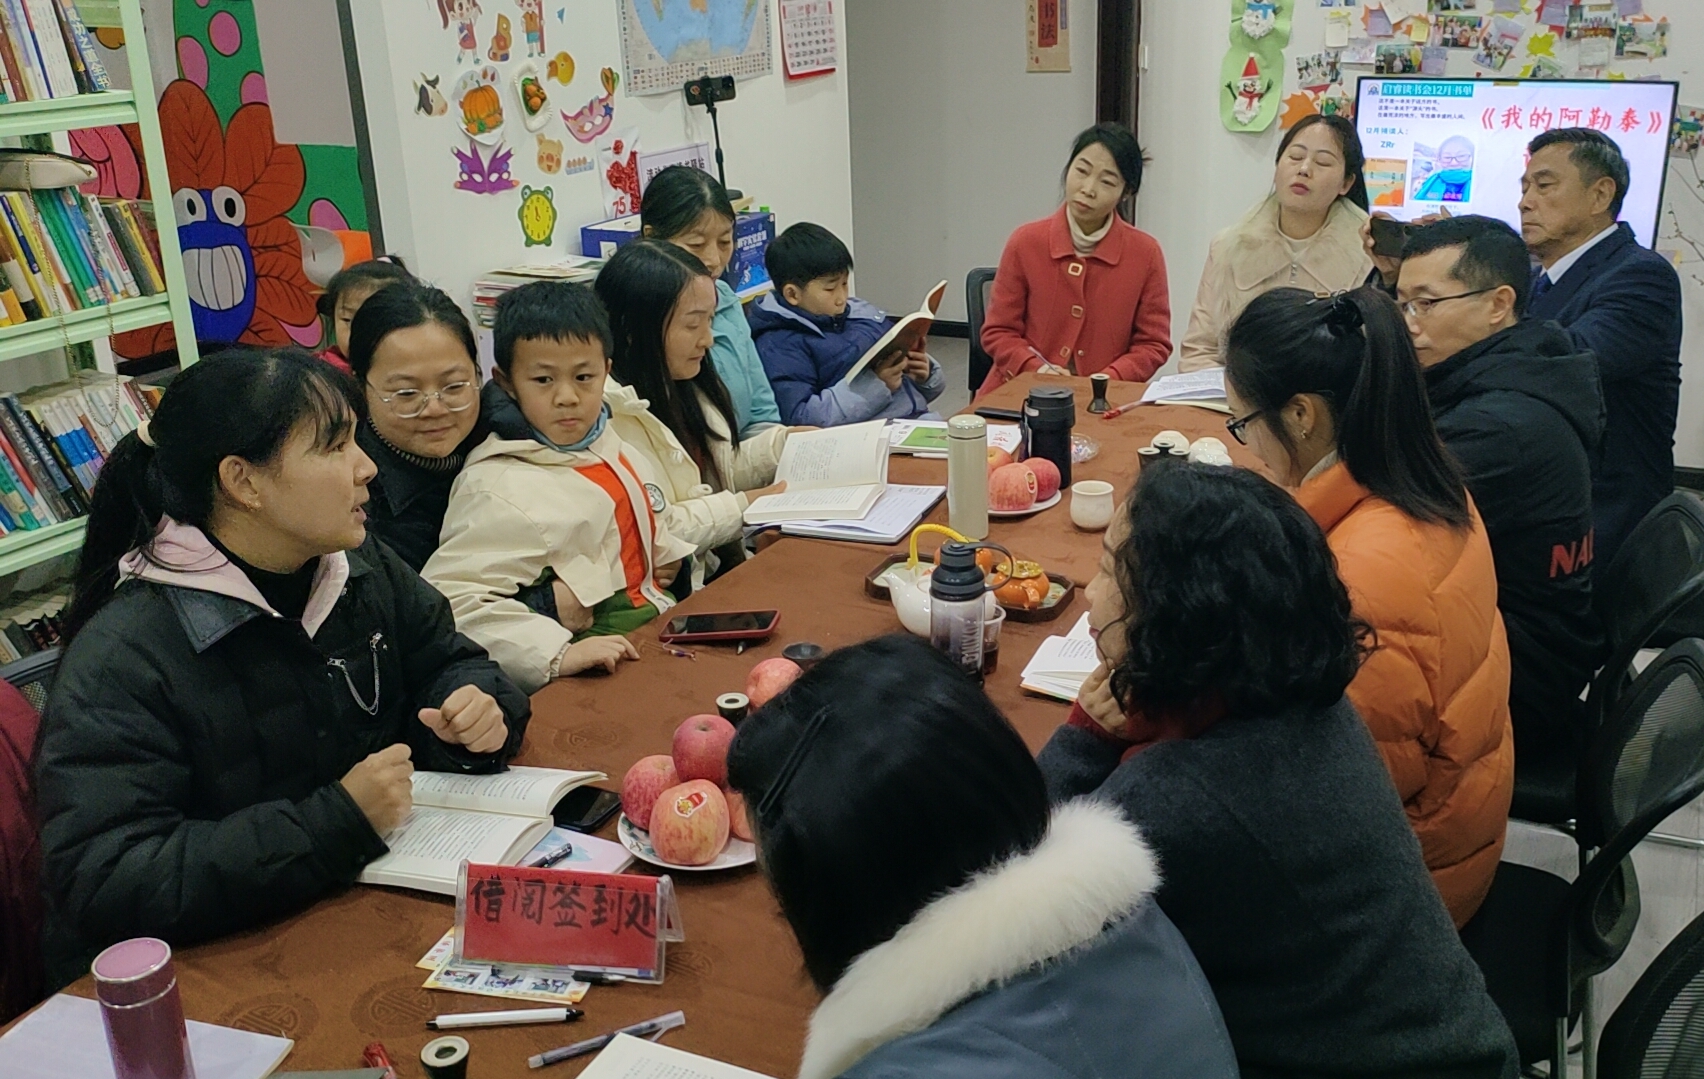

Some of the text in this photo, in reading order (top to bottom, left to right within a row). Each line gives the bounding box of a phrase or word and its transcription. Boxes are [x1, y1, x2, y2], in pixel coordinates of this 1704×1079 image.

[1481, 105, 1662, 134] 《我的阿勒泰》
[470, 875, 657, 939] 借阅签到处
